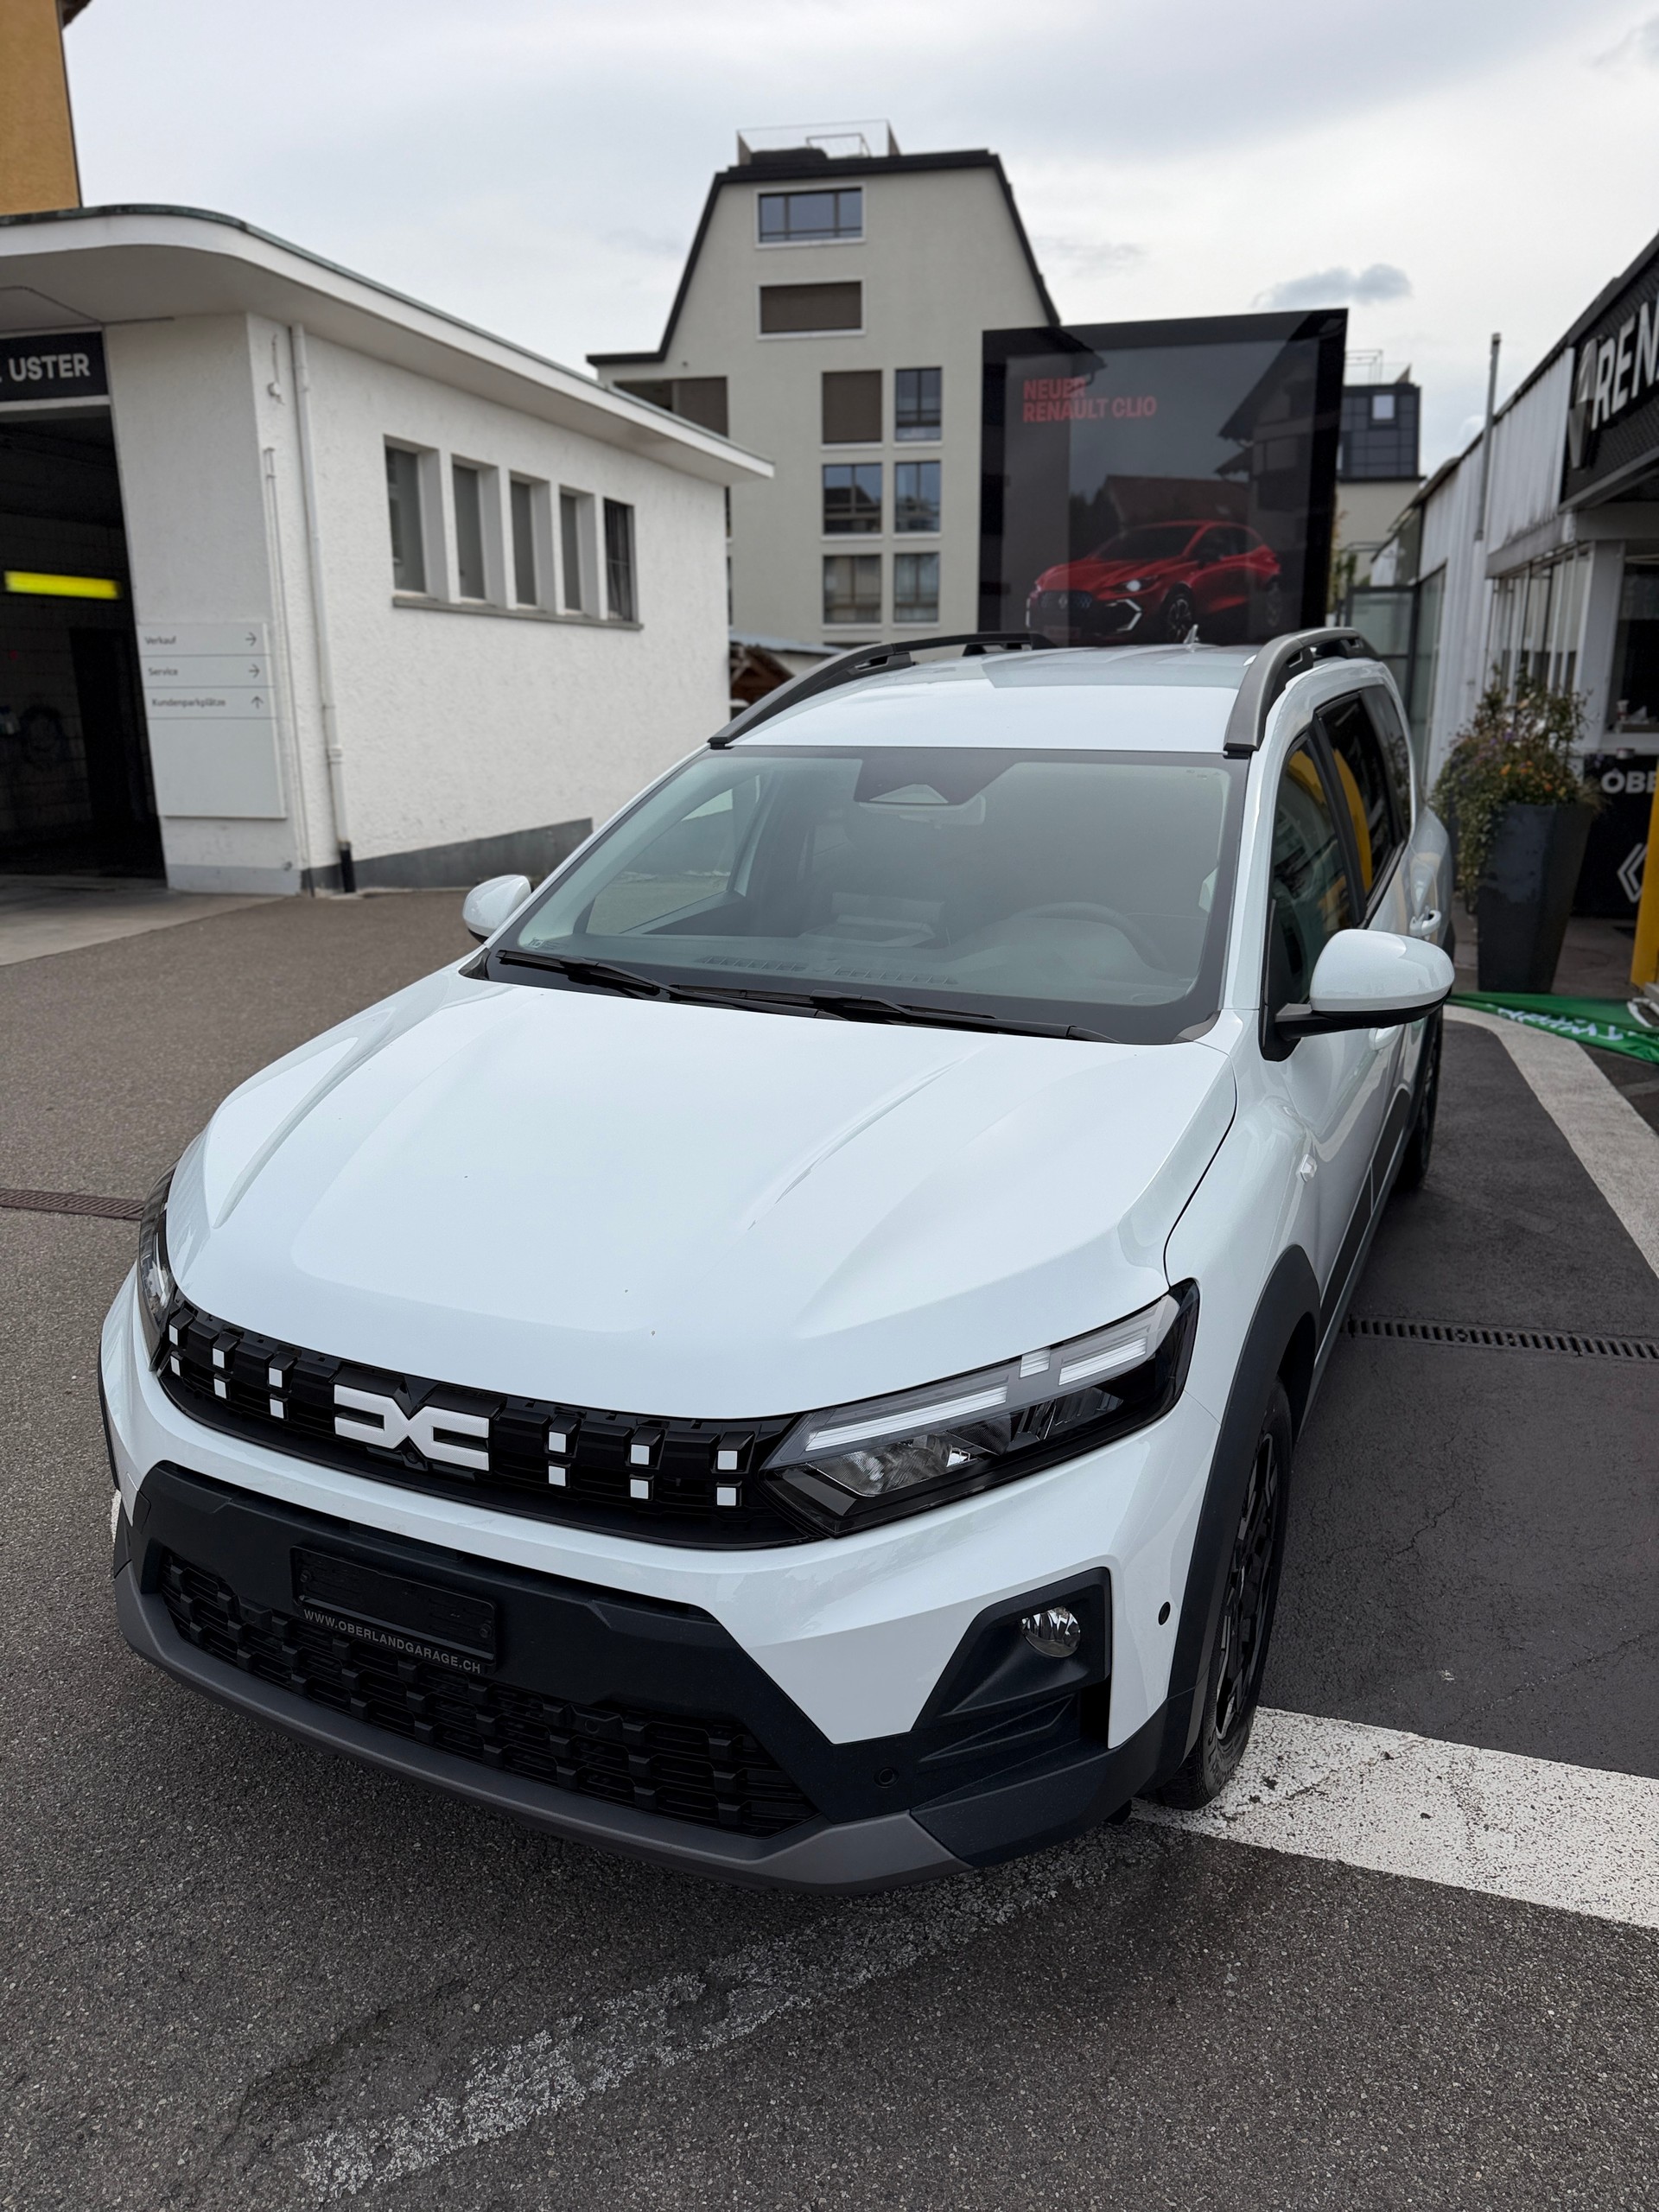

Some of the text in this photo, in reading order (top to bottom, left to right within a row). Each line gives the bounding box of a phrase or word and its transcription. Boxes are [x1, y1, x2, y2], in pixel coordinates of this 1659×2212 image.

[8, 353, 91, 381] USTER
[1591, 287, 1659, 430] REN
[1023, 377, 1086, 400] NEUER
[1023, 395, 1158, 423] RENAULT CLIO
[144, 636, 176, 645] Verkauf
[148, 667, 178, 676] Service
[152, 697, 226, 708] Kundenparkplätze
[303, 1609, 481, 1674] WWW.OBERLANDGARAGE.CH
